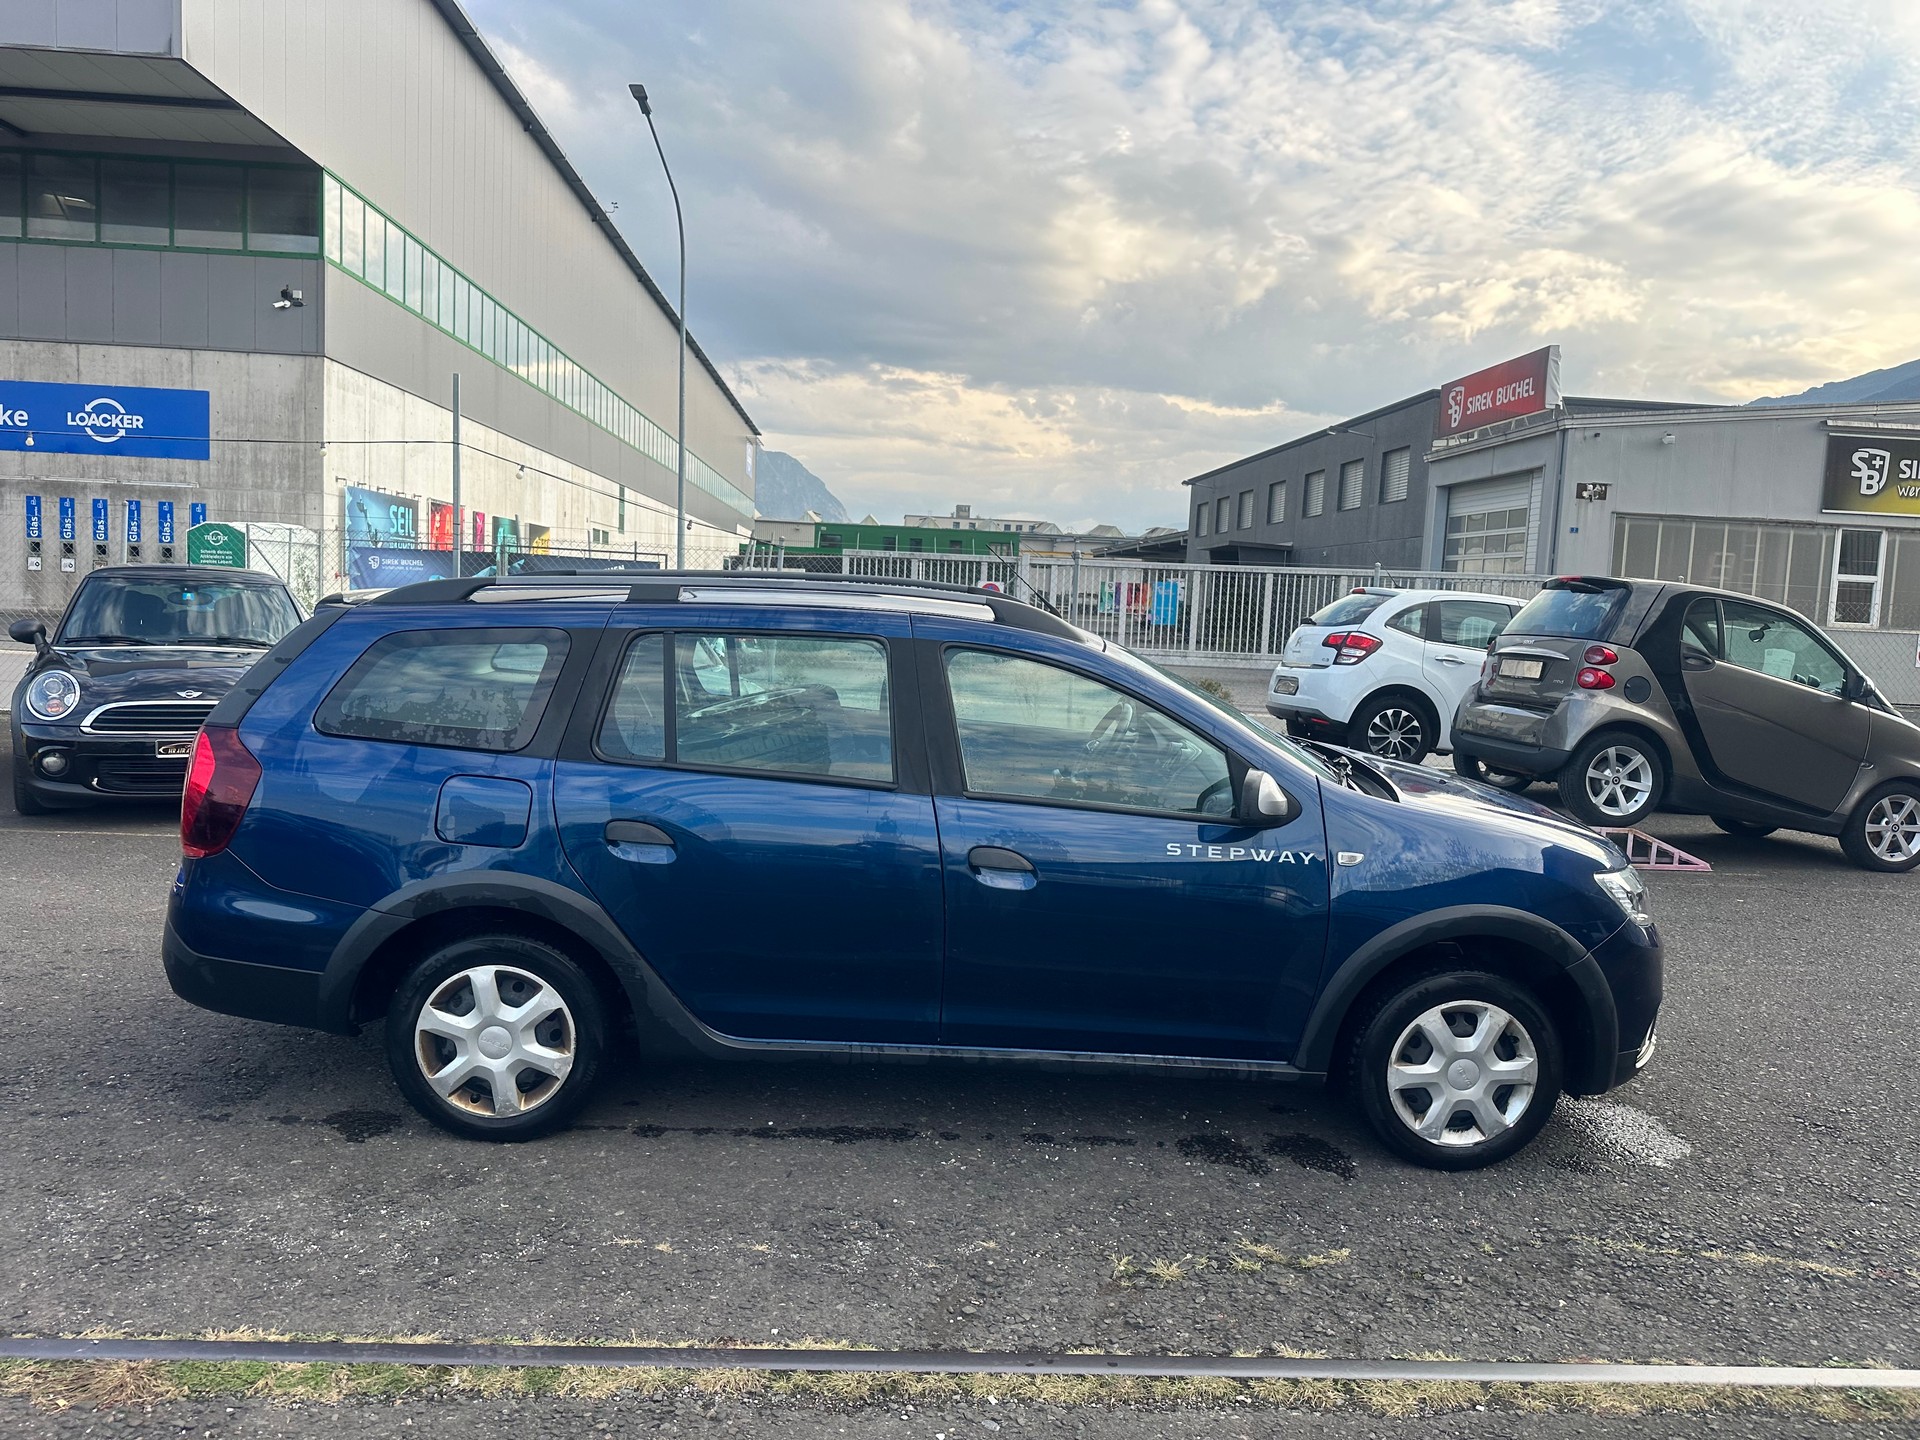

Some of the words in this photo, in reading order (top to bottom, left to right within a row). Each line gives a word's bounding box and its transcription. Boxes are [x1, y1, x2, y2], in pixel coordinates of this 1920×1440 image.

[1466, 390, 1494, 415] SIREK
[67, 412, 144, 429] LOACKER
[30, 516, 38, 537] Glas
[63, 518, 71, 539] Glas
[96, 520, 105, 540] Glas
[389, 504, 416, 537] SEIL
[129, 521, 138, 542] Glas
[162, 523, 171, 543] Glas
[1166, 843, 1316, 865] STEPWAY
